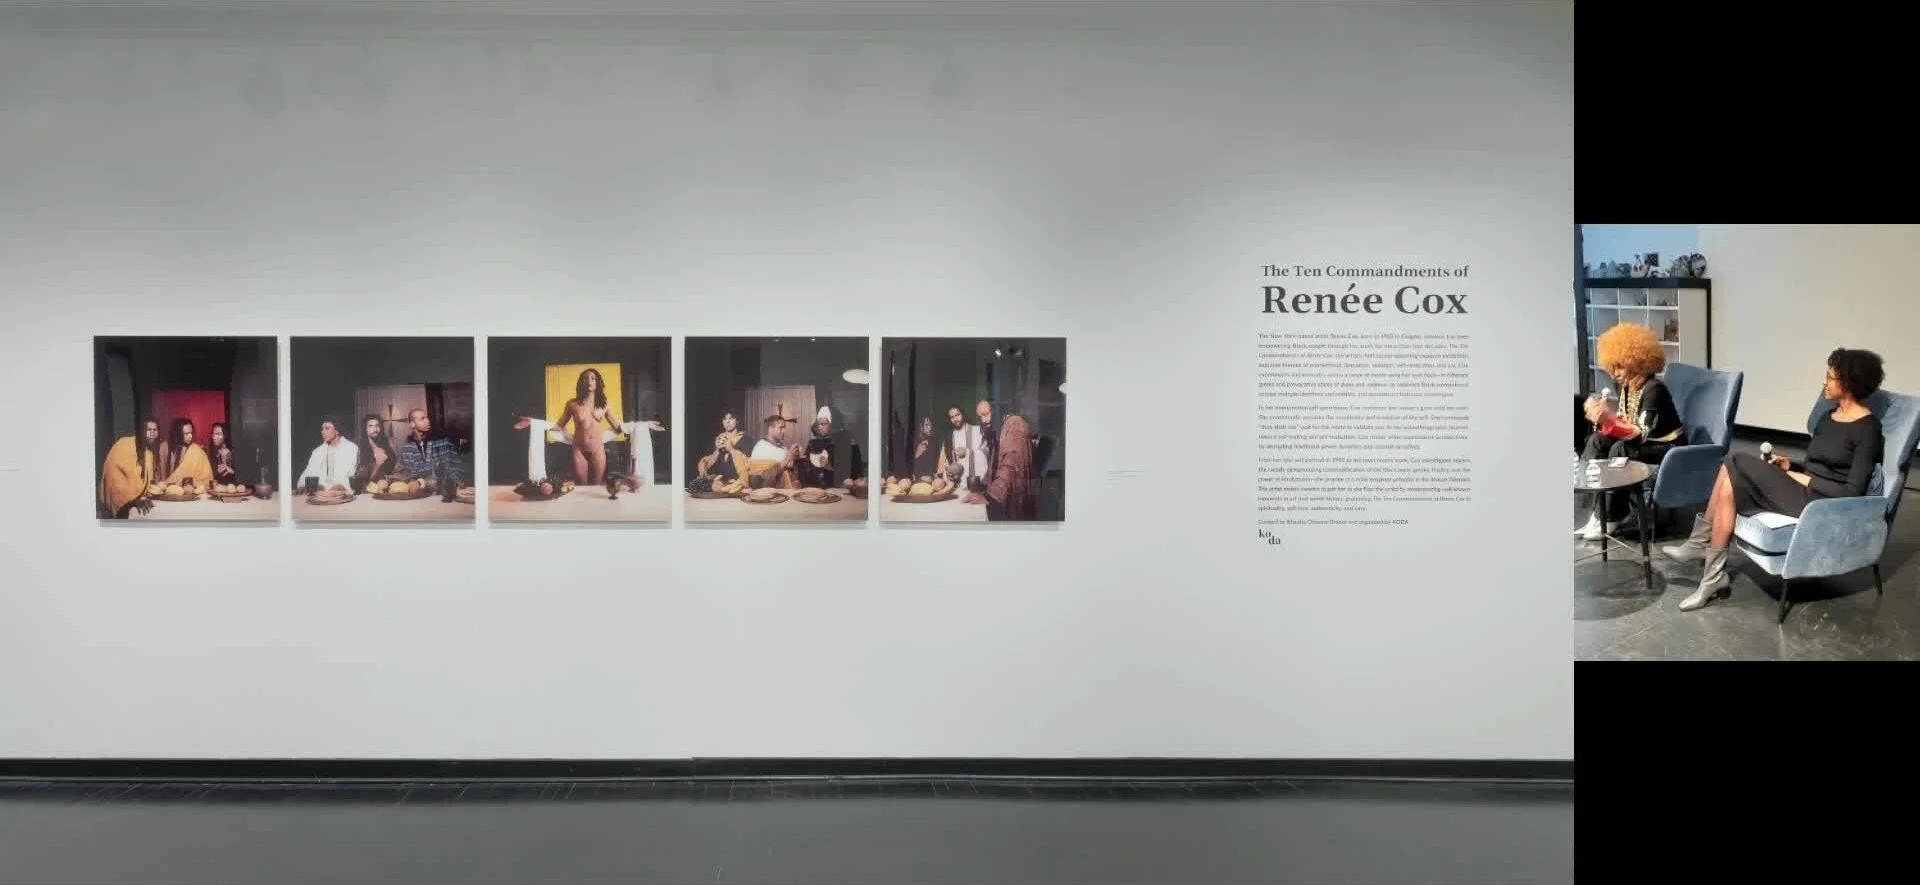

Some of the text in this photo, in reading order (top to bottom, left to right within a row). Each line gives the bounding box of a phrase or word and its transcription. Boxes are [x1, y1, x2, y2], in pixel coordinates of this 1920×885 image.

[1261, 264, 1470, 278] The Ten Commandments of
[1261, 282, 1469, 314] Renée Cox
[1259, 528, 1272, 538] ko
[1268, 535, 1281, 545] da
